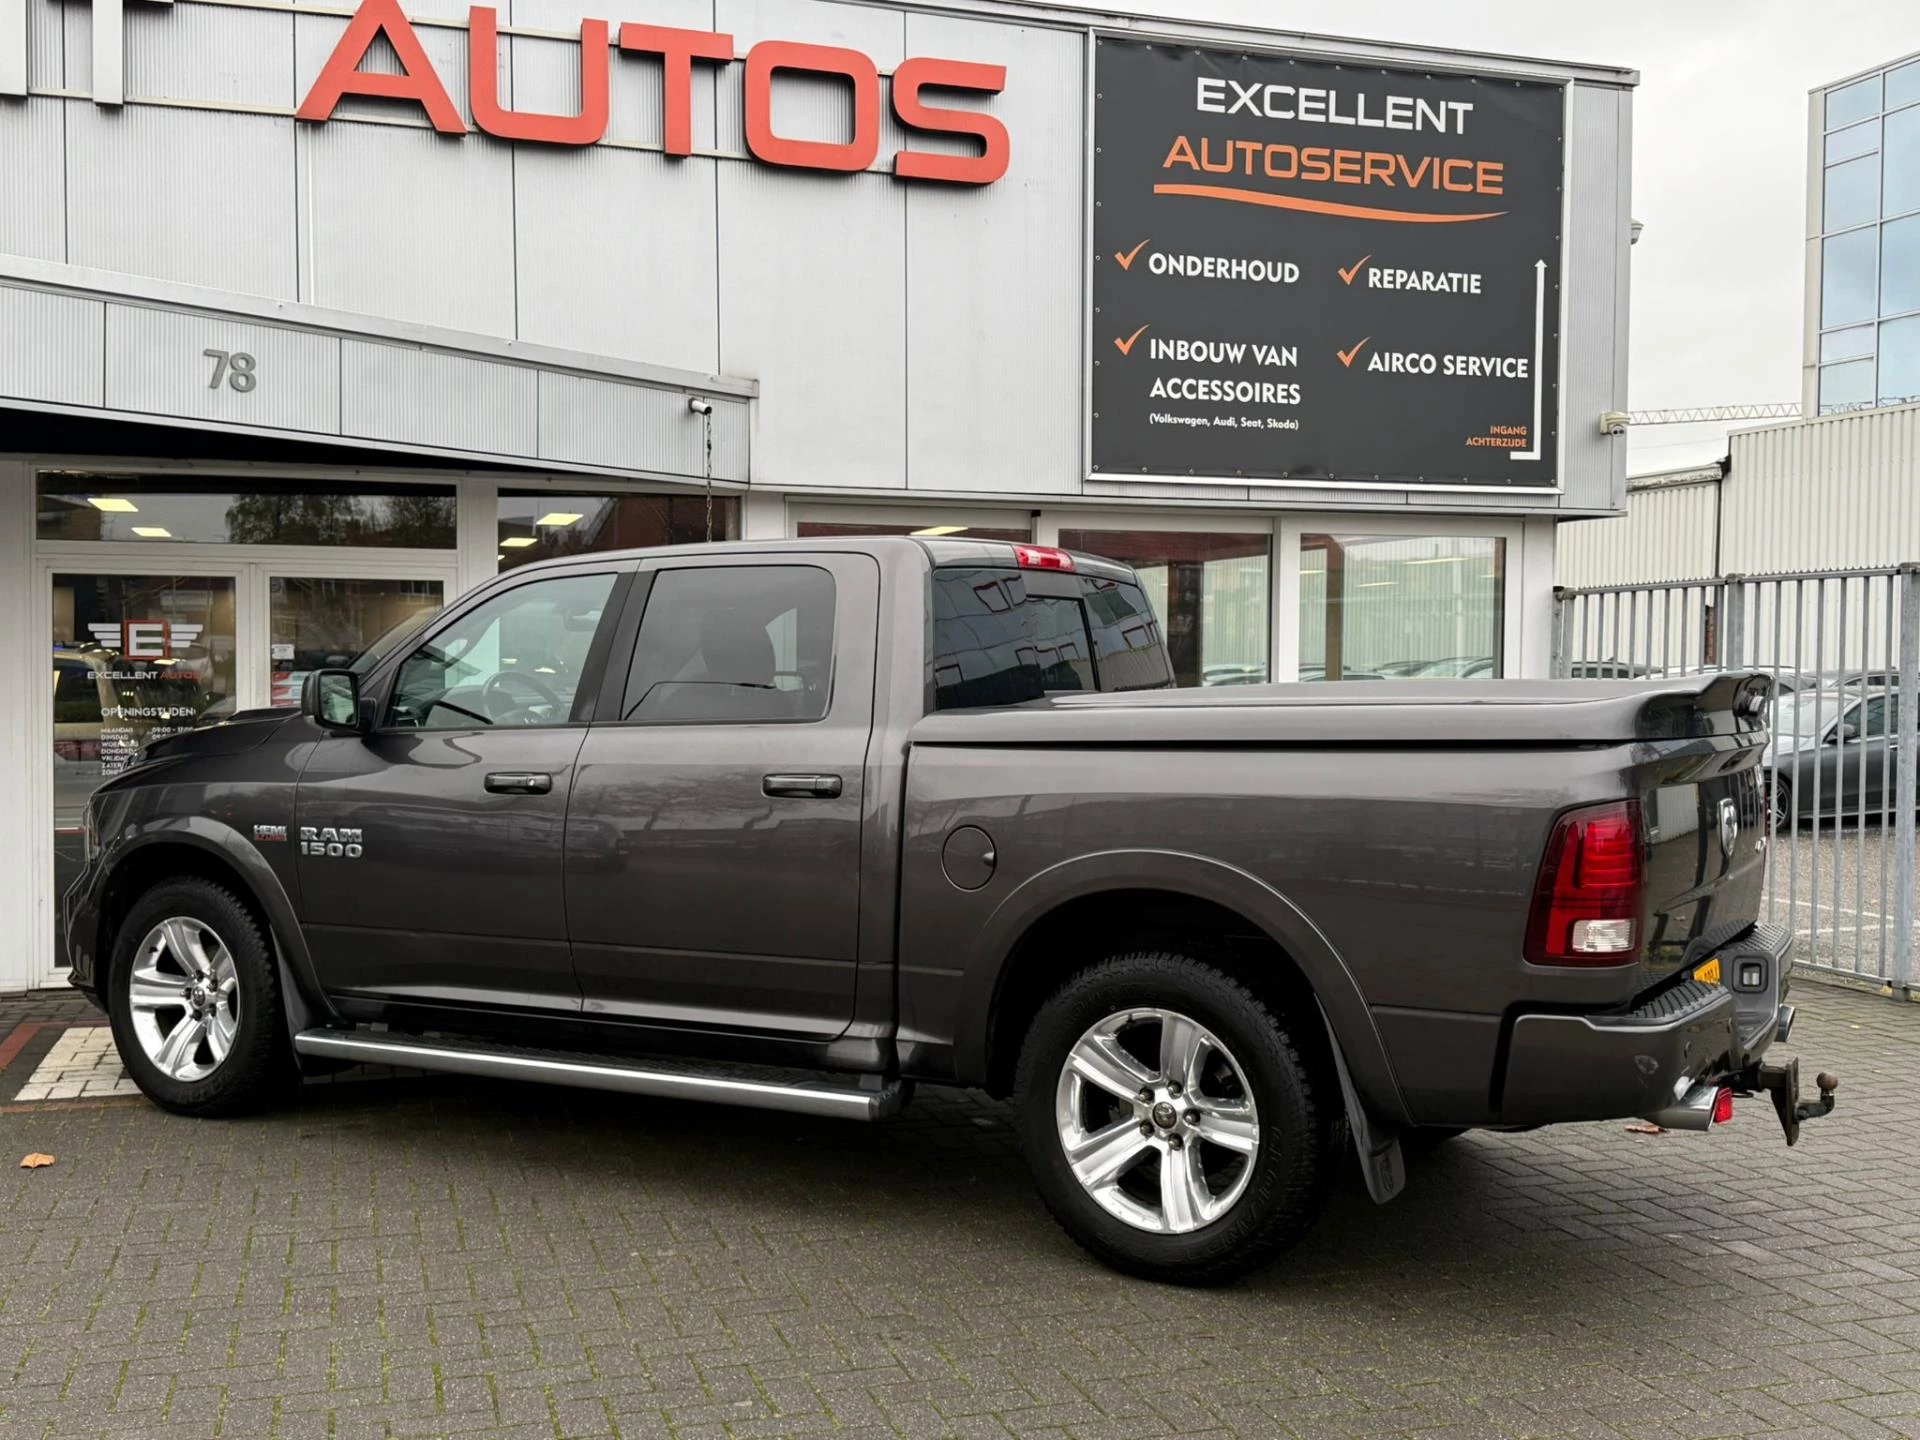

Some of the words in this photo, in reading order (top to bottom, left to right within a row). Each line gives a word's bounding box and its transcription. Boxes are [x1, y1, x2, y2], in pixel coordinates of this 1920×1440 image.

[295, 0, 1010, 184] AUTOS
[1196, 76, 1474, 135] EXCELLENT
[1162, 135, 1504, 195] AUTOSERVICE
[1148, 252, 1300, 284] ONDERHOUD
[1367, 267, 1482, 295] REPARATIE
[1149, 338, 1247, 364] INBOUW
[1251, 343, 1298, 367] VAN
[1367, 351, 1437, 375] AIRCO
[1442, 355, 1529, 379] SERVICE
[203, 347, 257, 393] 78
[1149, 377, 1301, 405] ACCESSOIRES
[1149, 412, 1210, 428] (Volkswagen,
[1213, 416, 1238, 429] Audi,
[1240, 417, 1264, 430] Seat,
[1267, 418, 1299, 430] Skoda)
[1489, 425, 1528, 436] INGANG
[87, 671, 158, 680] EXCELLENT
[160, 671, 200, 680] AUTOS
[300, 826, 363, 842] RAM
[300, 841, 363, 858] 1500
